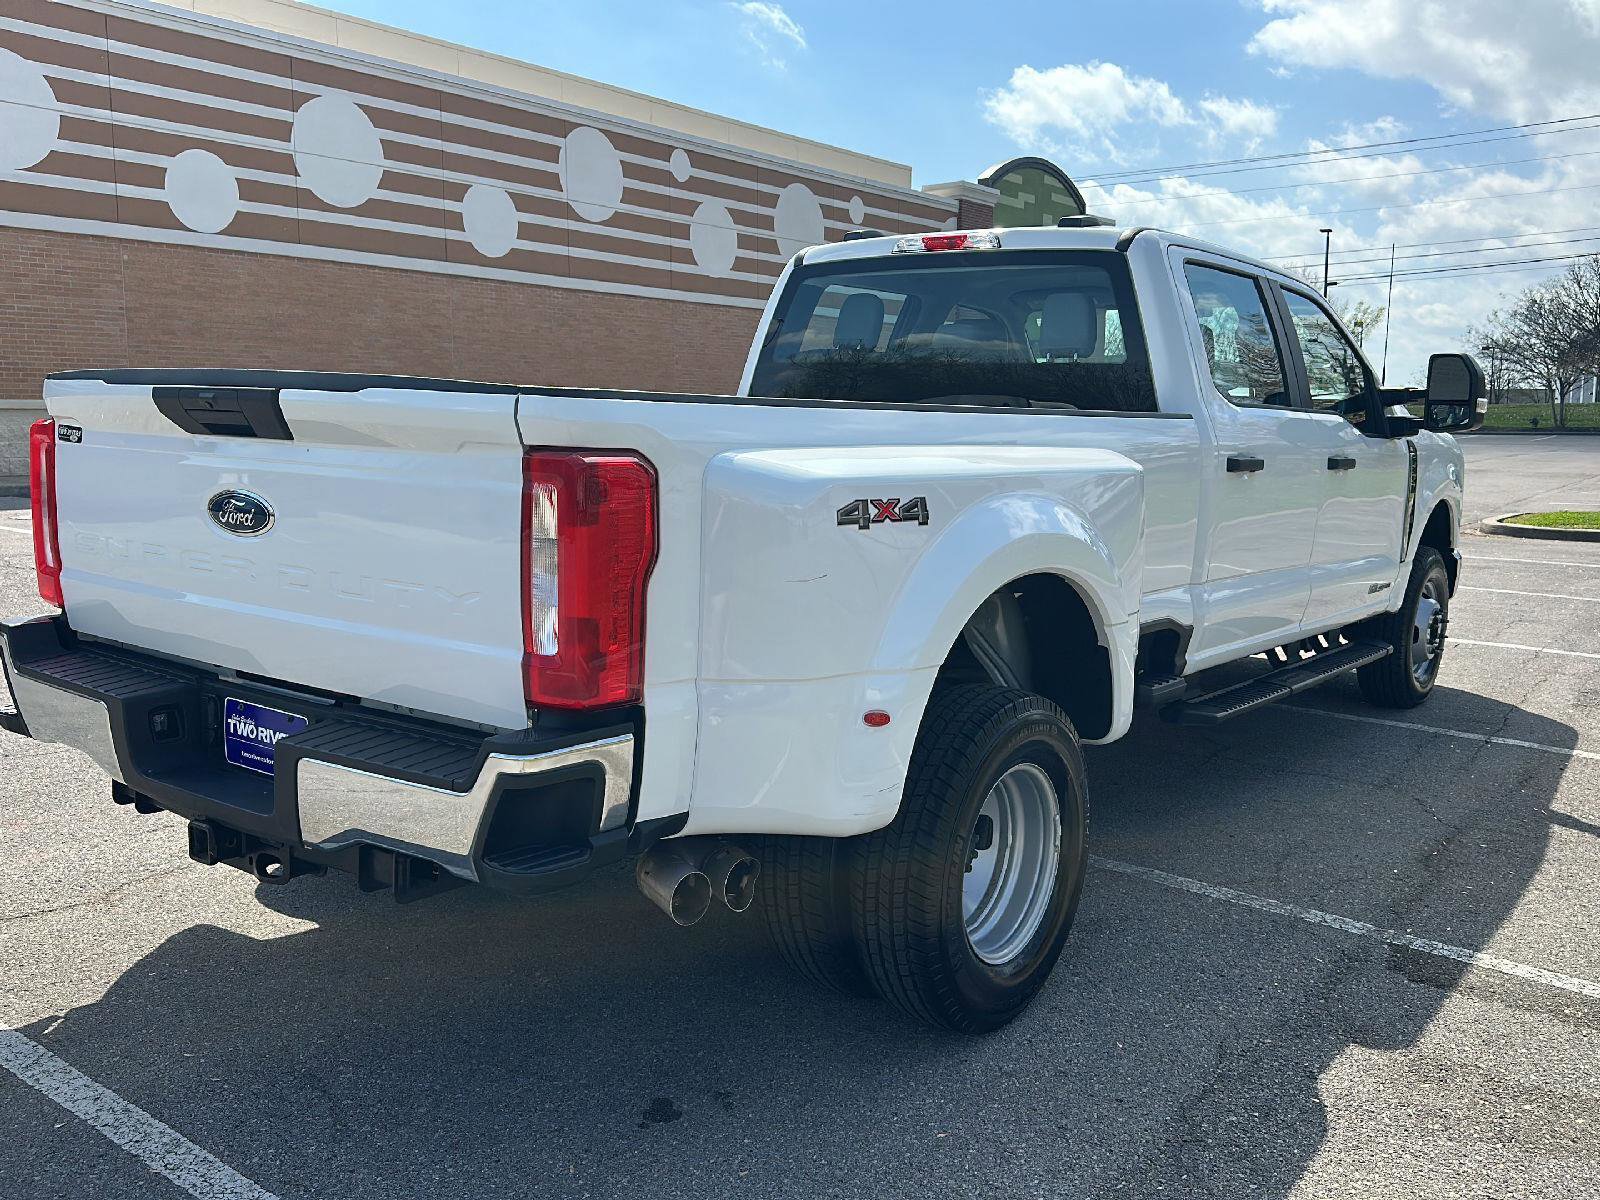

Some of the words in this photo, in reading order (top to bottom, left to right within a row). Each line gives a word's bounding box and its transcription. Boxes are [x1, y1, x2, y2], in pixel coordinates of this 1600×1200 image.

[219, 499, 255, 526] Ford
[75, 532, 257, 580] SUPER
[277, 562, 480, 616] DUTY
[227, 718, 257, 739] TWO
